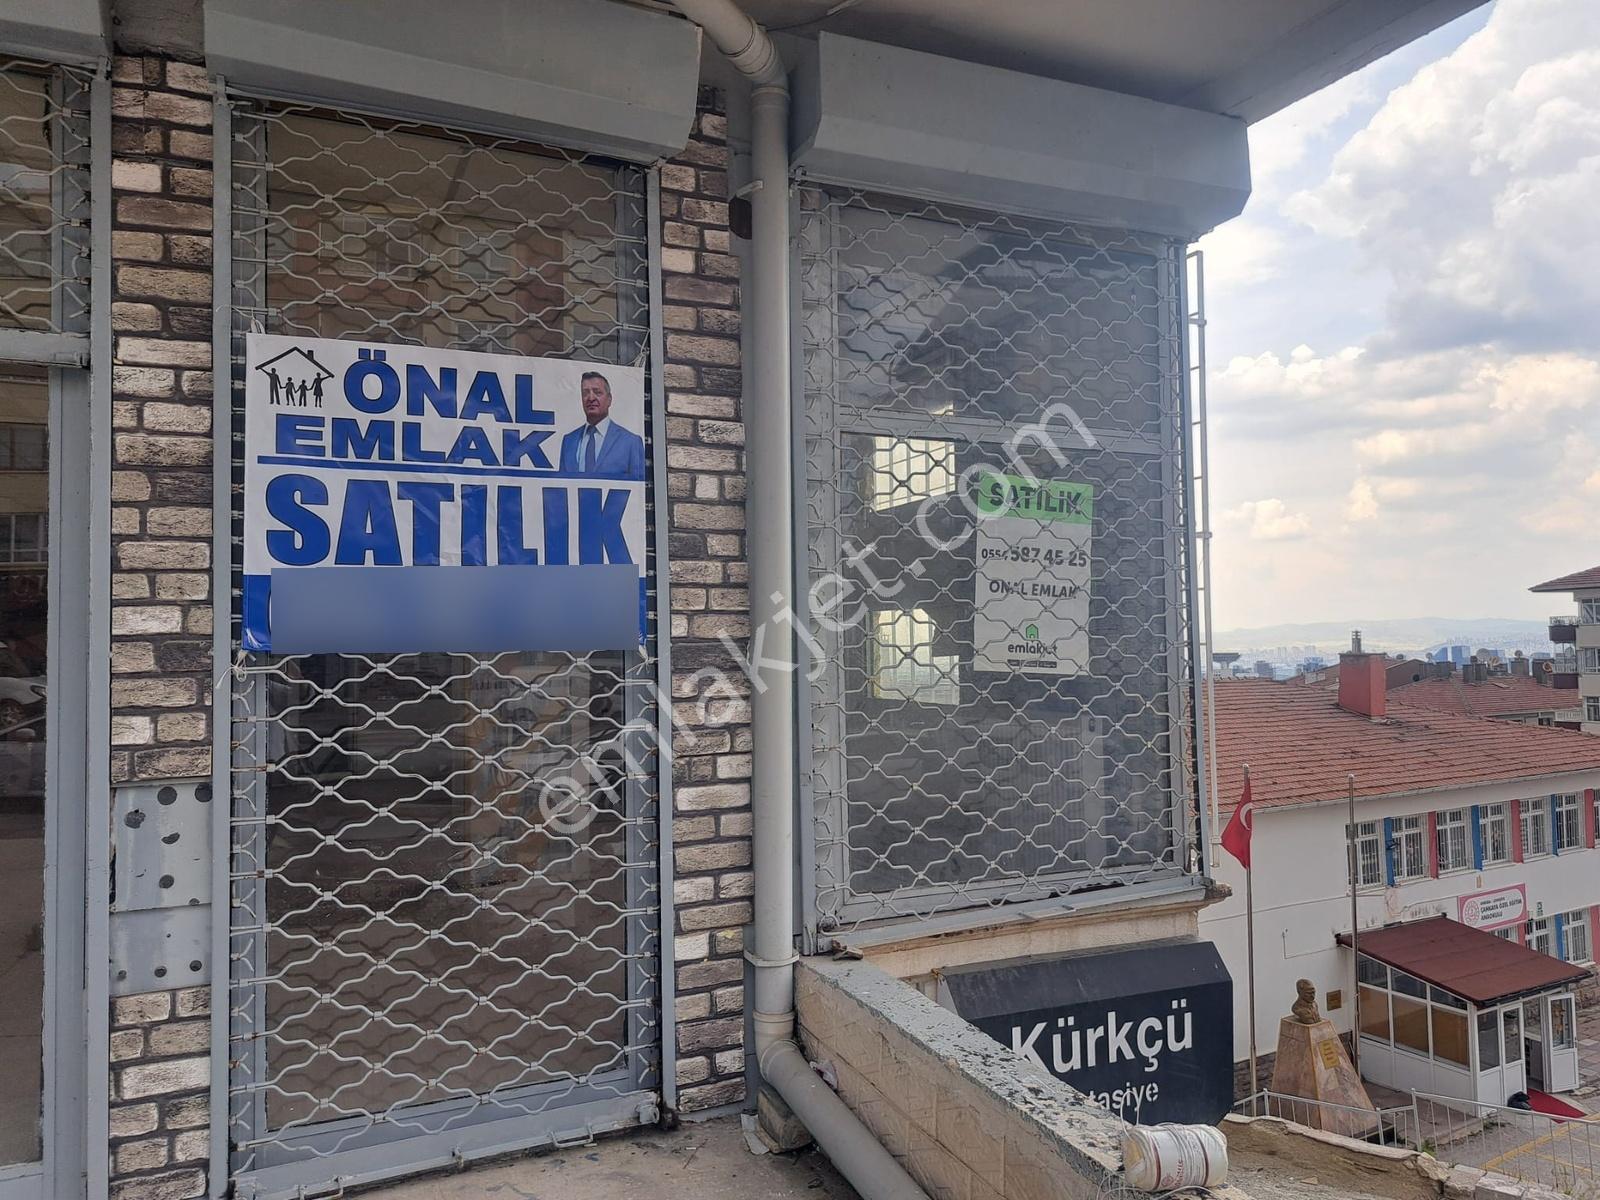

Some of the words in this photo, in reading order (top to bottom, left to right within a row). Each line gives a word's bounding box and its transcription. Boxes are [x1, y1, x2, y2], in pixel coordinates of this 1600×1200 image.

[343, 348, 555, 425] ÖNAL
[275, 413, 556, 469] EMLAK
[265, 473, 633, 567] SATILIK
[990, 482, 1082, 515] SATILIK
[1011, 998, 1193, 1073] Kürkçü
[1088, 1082, 1160, 1113] tasiye
